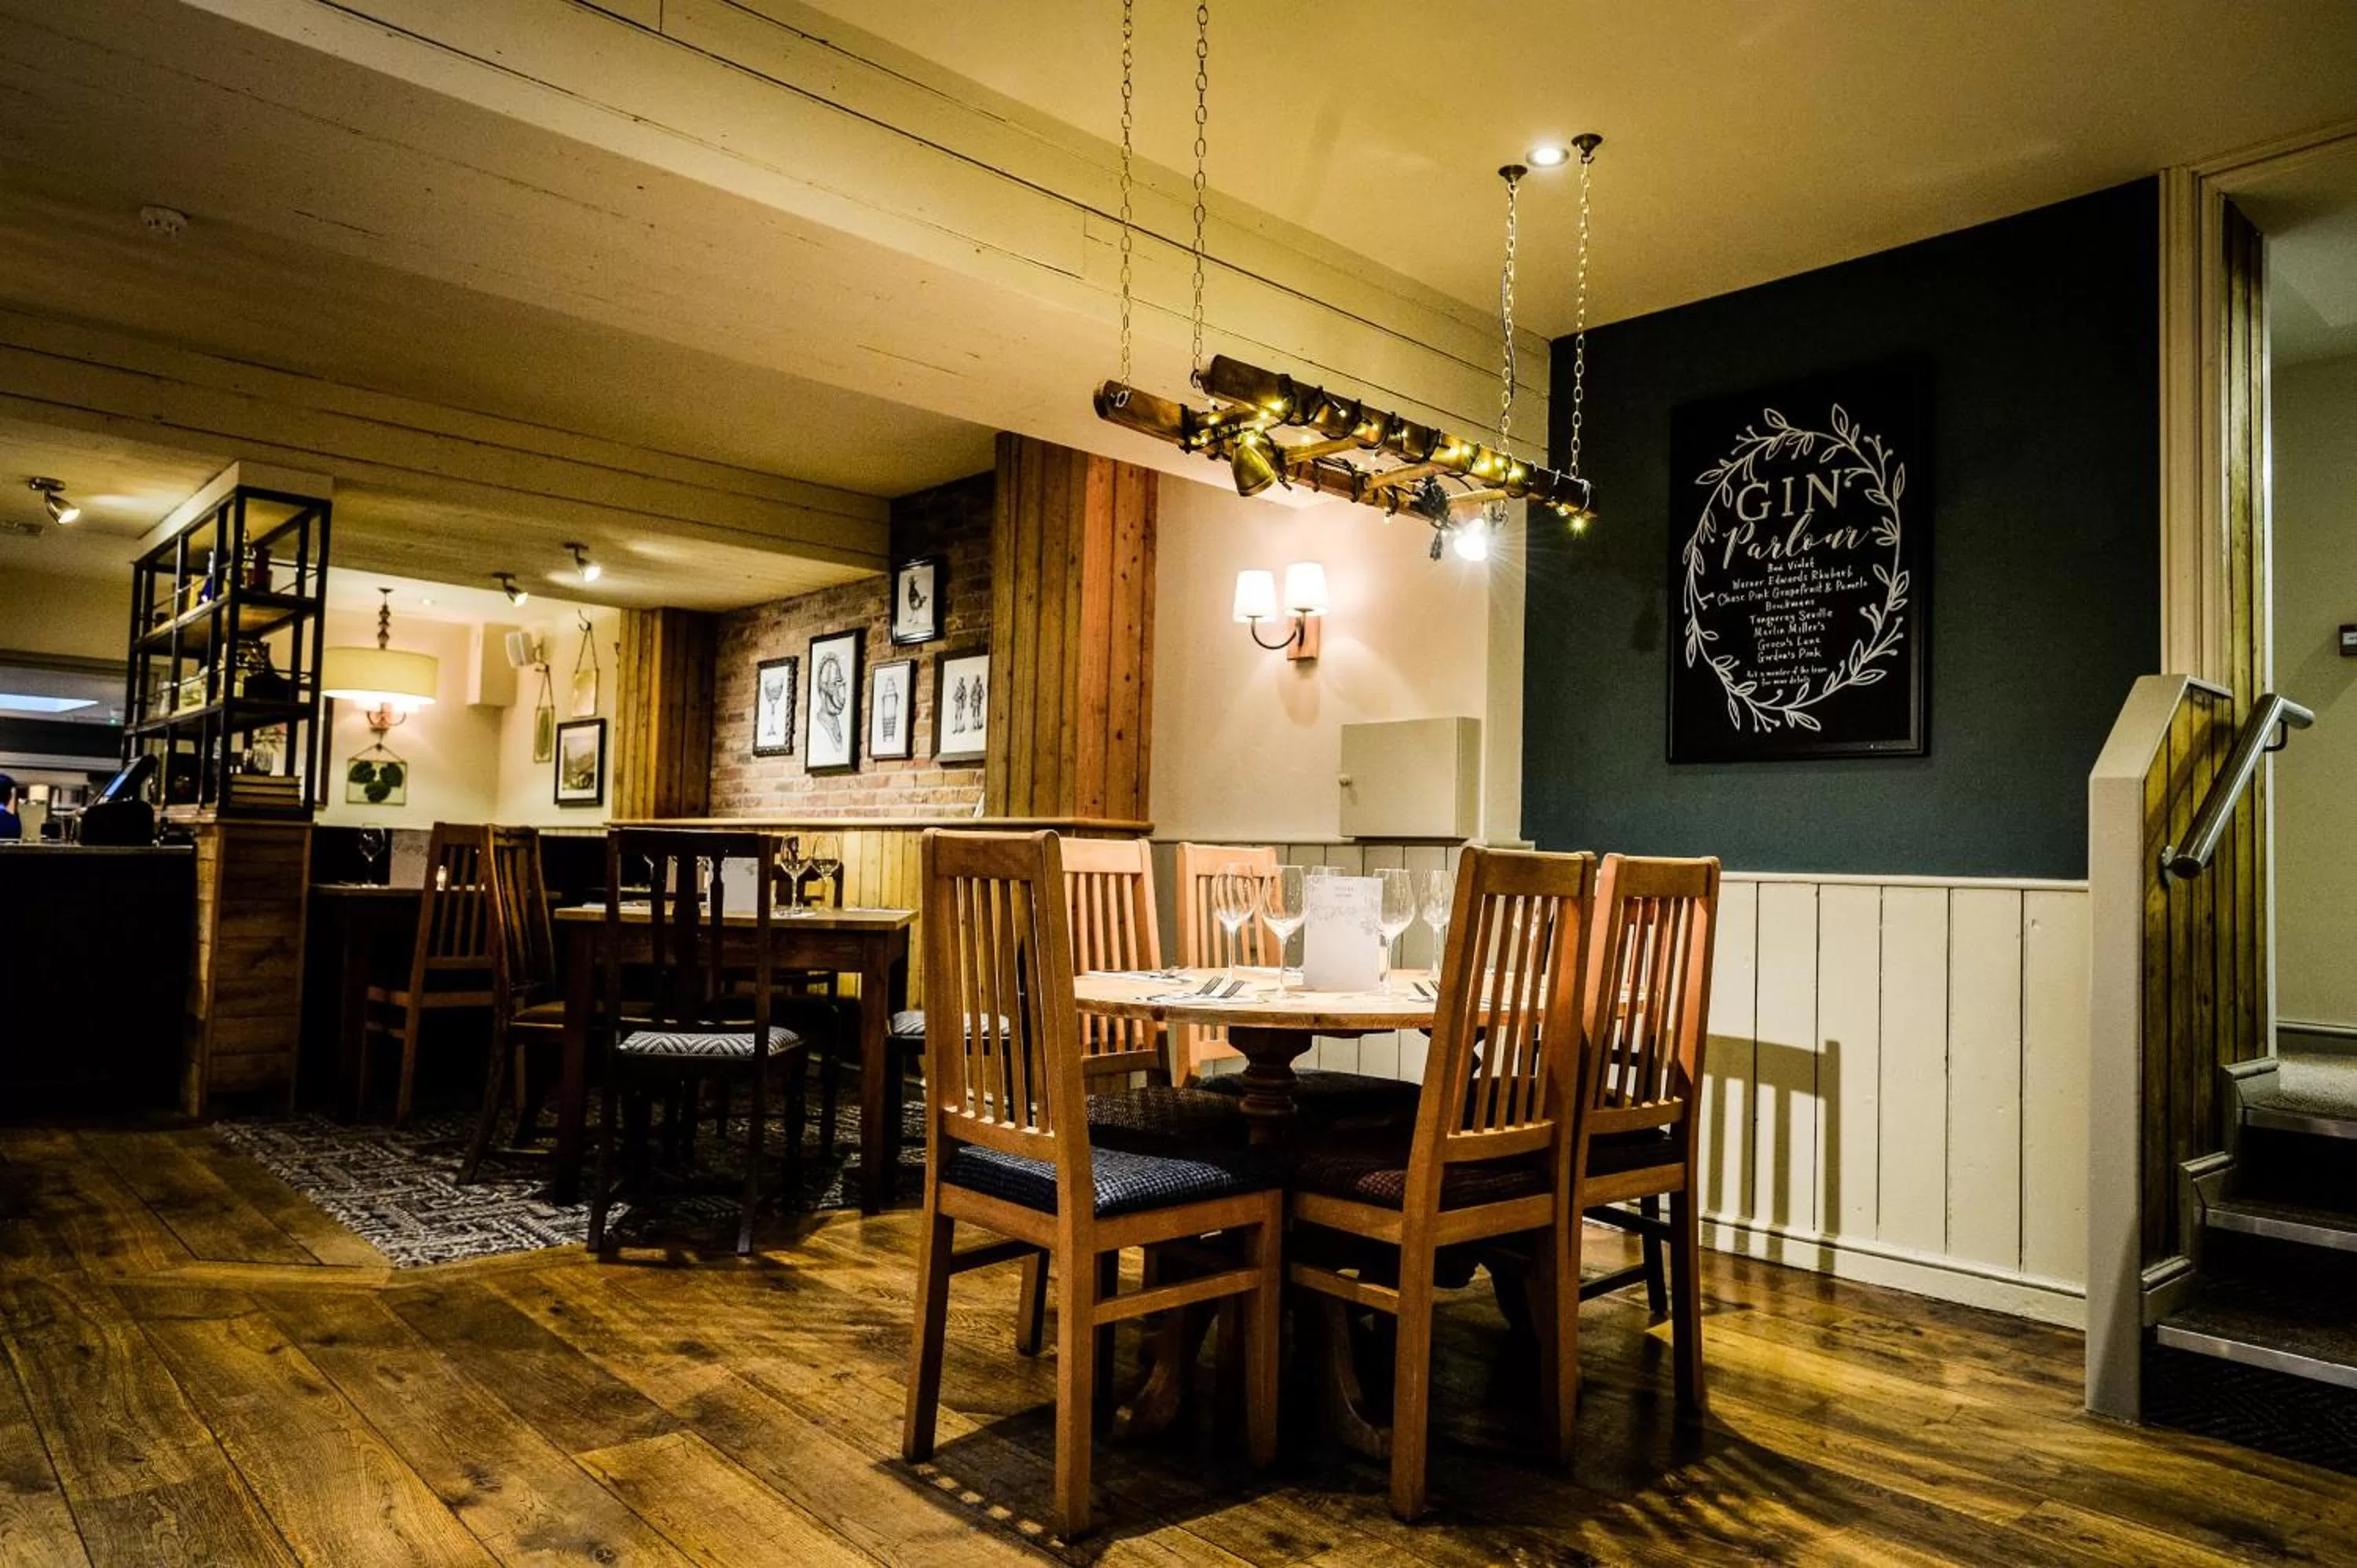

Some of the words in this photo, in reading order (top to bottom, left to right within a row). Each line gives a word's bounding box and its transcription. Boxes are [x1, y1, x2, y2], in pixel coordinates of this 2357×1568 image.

[1736, 469, 1842, 522] GIN
[1722, 513, 1869, 570] Parlour
[1768, 570, 1808, 585] Edwards
[1748, 588, 1769, 601] Pink
[1798, 647, 1822, 659] Pink
